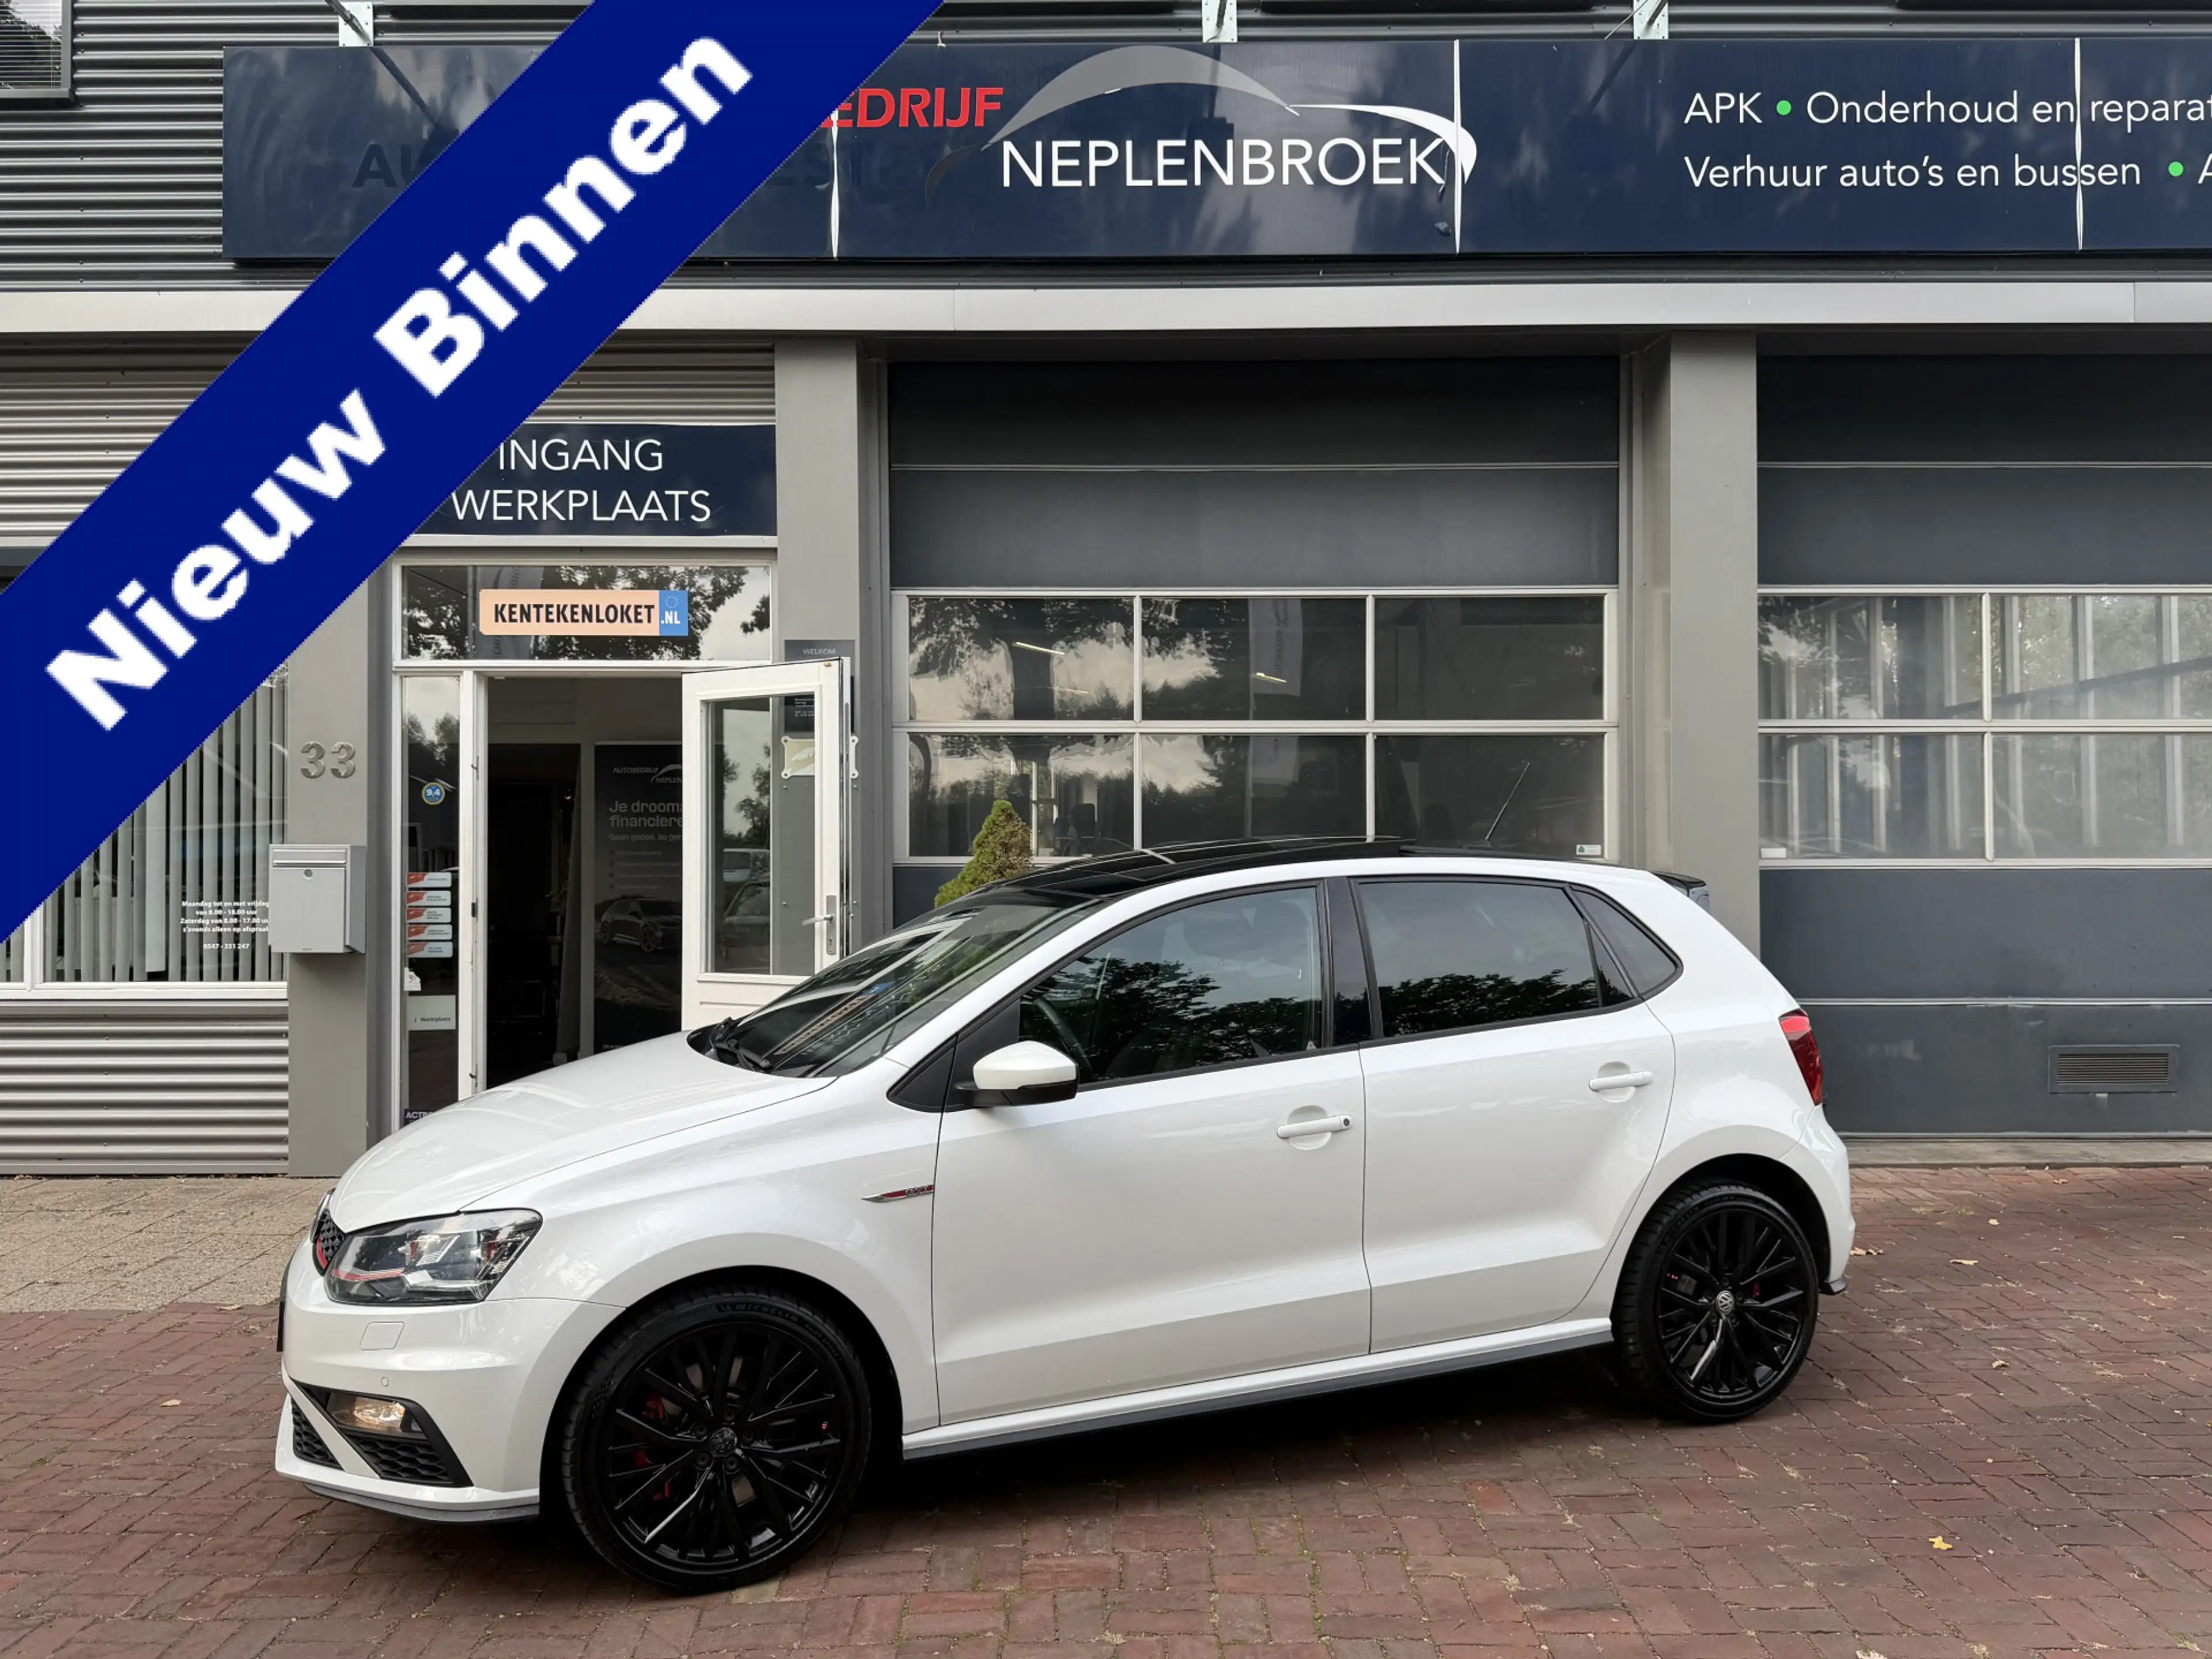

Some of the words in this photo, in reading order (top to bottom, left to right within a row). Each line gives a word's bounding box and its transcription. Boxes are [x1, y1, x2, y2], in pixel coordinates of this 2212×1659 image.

[821, 88, 1003, 128] EDRIJF
[1684, 92, 1763, 124] APK
[1807, 89, 2018, 123] Onderhoud
[2032, 101, 2074, 123] en
[1003, 137, 1446, 187] NEPLENBROEK
[1684, 154, 1828, 187] Verhuur
[1839, 156, 1944, 187] auto's
[1957, 165, 1999, 187] en
[2014, 153, 2140, 187] bussen
[499, 438, 663, 471] INGANG
[452, 489, 711, 522] WERKPLAATS
[494, 604, 656, 623] KENTEKENLOKET
[300, 741, 356, 779] 33
[609, 800, 627, 813] Je
